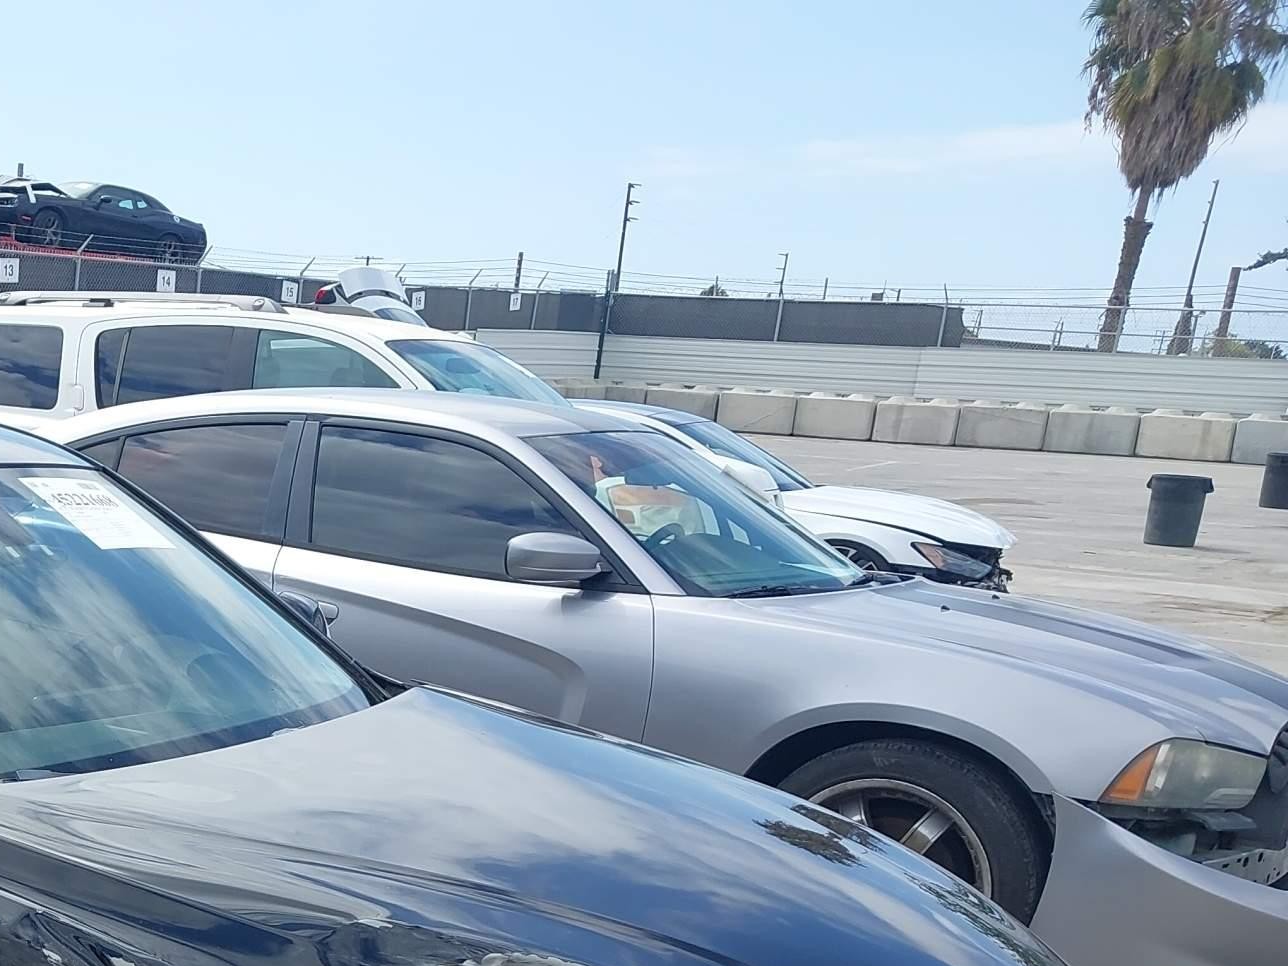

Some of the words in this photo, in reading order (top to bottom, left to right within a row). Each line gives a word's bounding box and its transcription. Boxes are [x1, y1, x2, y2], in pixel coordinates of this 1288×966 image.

[3, 263, 15, 277] 13
[161, 275, 172, 287] 14
[285, 286, 294, 298] 15
[414, 295, 422, 306] 16
[511, 297, 519, 307] 17
